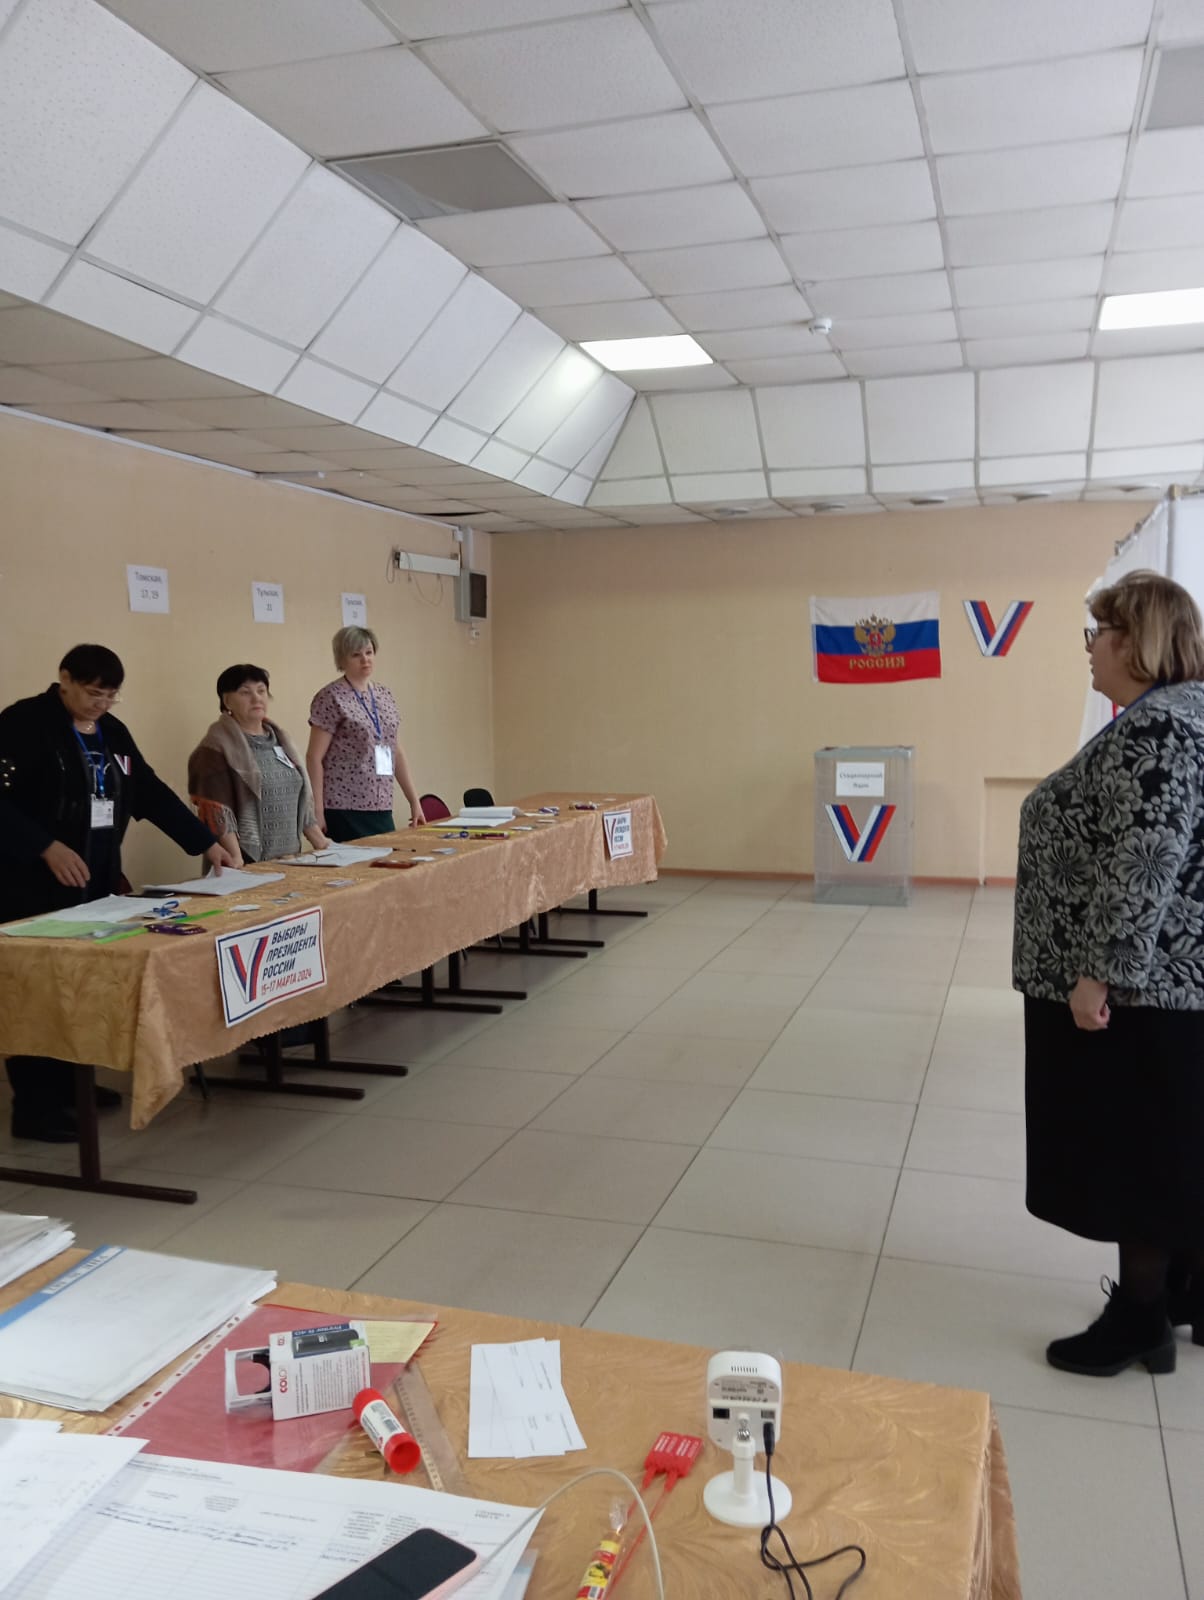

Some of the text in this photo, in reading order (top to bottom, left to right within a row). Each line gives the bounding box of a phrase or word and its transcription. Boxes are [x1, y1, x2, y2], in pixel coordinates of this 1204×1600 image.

[849, 655, 905, 670] РОССИЯ
[271, 922, 309, 945] ВЫБОРЫ
[265, 934, 317, 963] ПРЕЗИДЕНТА
[262, 957, 296, 980] РОССИИ
[277, 973, 297, 989] МАРТА
[297, 967, 312, 981] 2024
[279, 1366, 288, 1393] COLO
